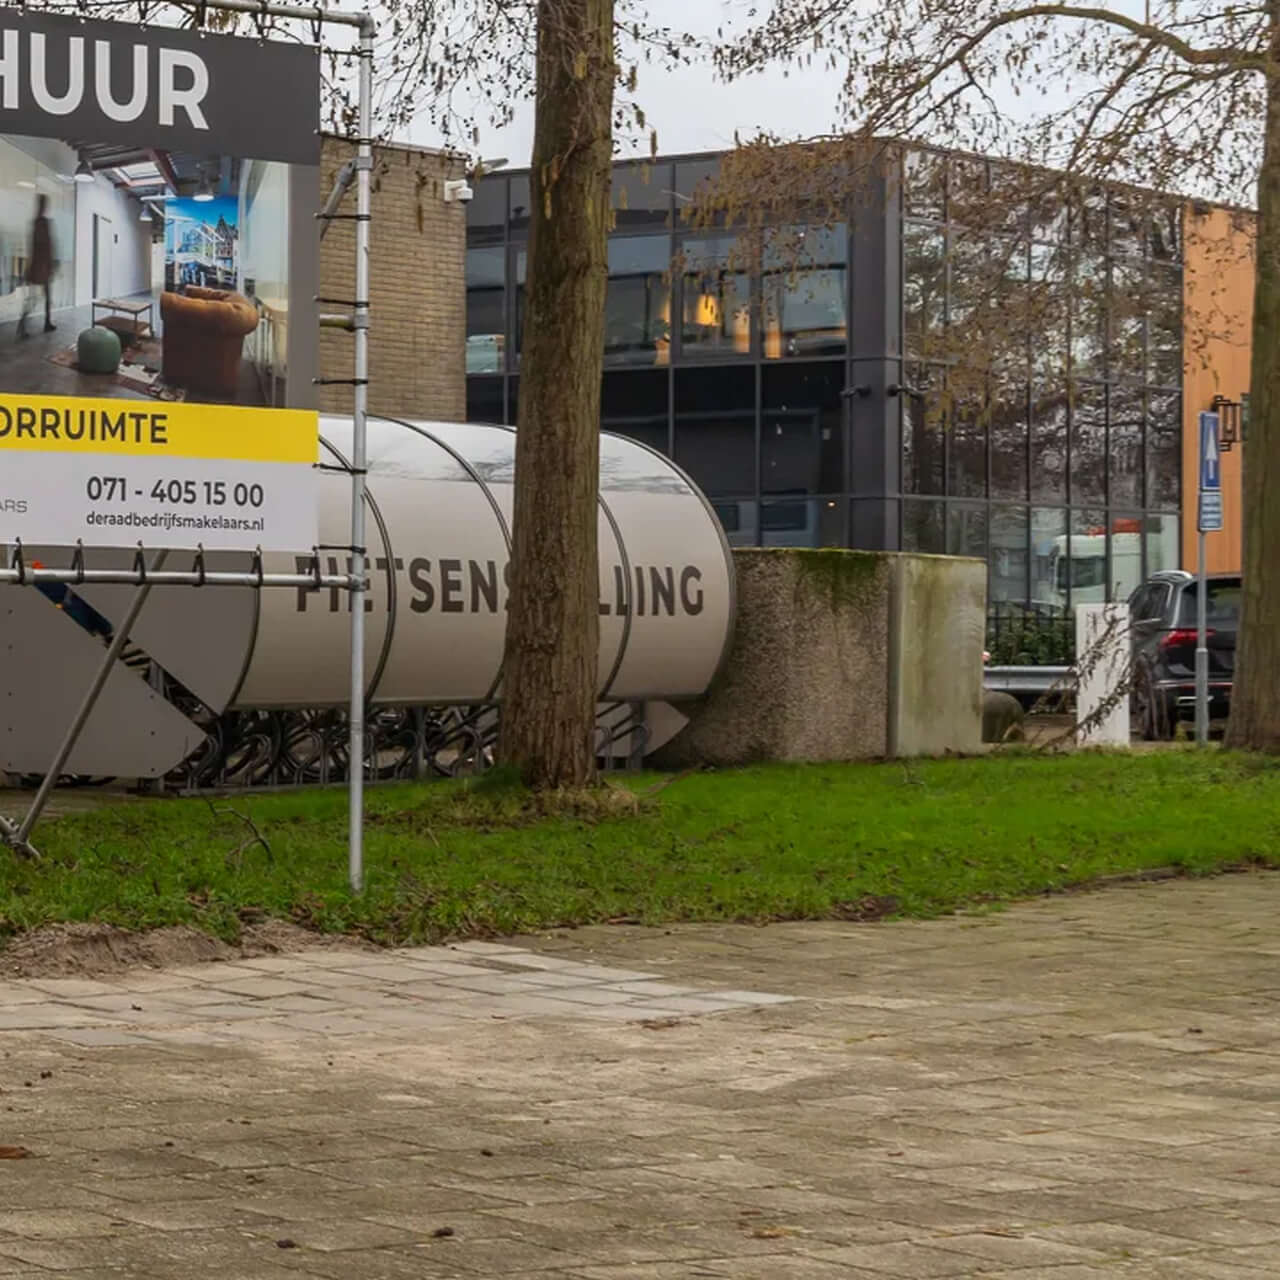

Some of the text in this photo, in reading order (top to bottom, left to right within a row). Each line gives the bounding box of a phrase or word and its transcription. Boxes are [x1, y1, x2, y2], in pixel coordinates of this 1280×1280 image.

[86, 476, 127, 502] 071
[150, 479, 197, 505] 405
[203, 481, 227, 506] 15
[233, 483, 265, 509] 00
[86, 510, 265, 531] deraadbedrijfsmakelaars.nl
